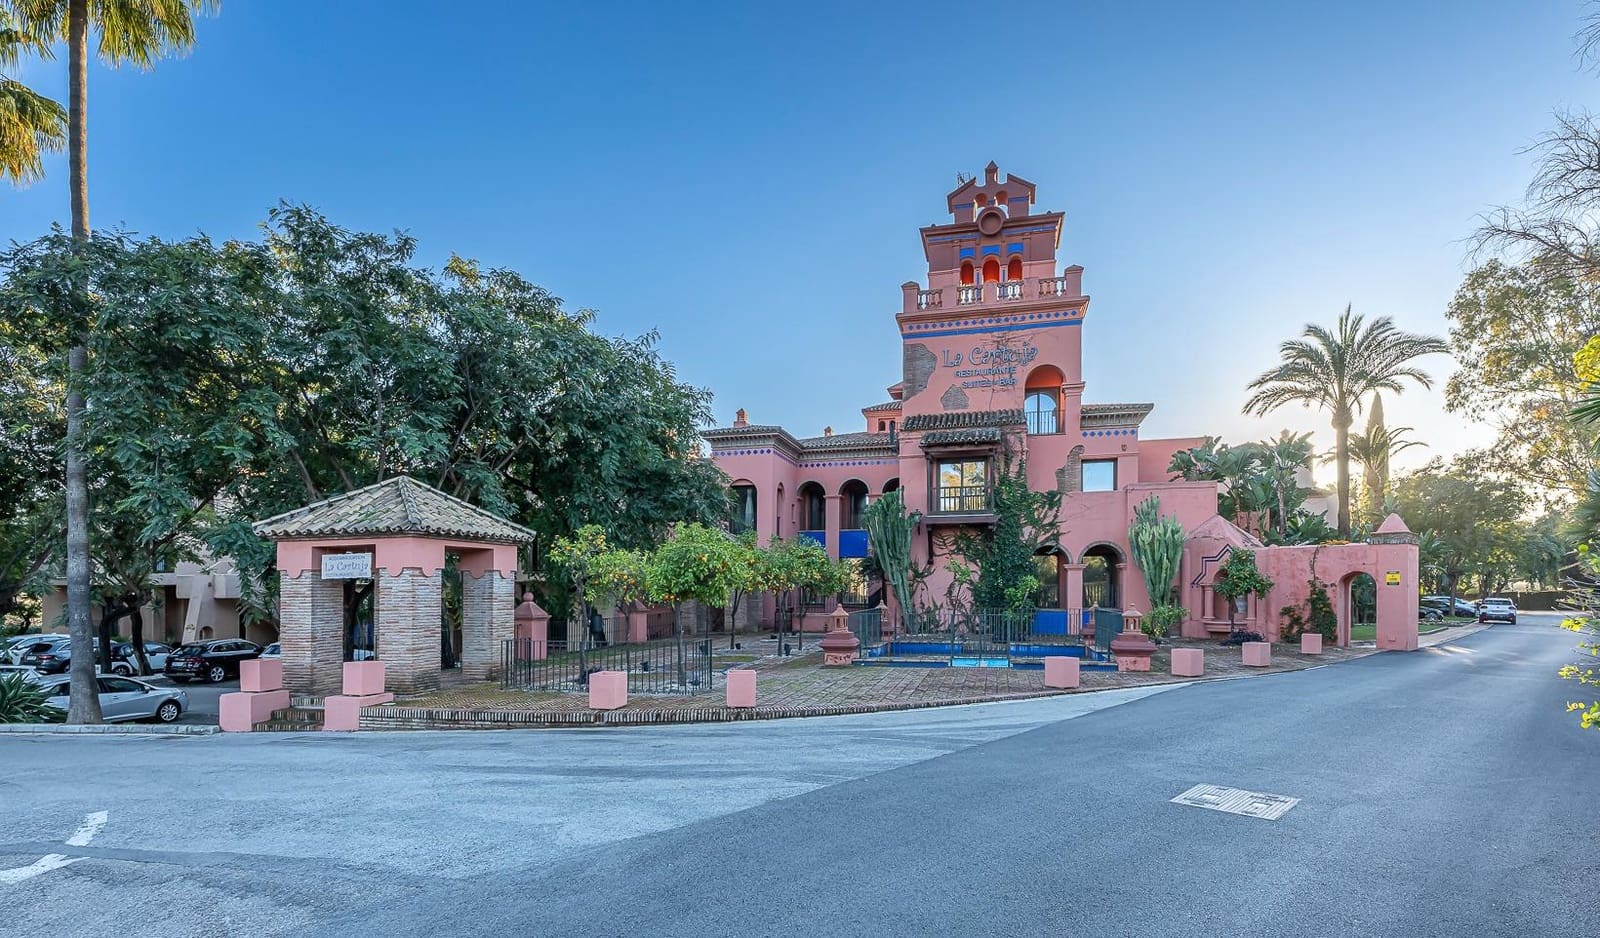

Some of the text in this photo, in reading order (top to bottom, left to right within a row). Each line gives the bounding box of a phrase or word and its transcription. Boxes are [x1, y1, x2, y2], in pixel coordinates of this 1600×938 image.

[942, 341, 1038, 368] La Cartuja
[954, 366, 1017, 377] RESTAURANTE
[325, 559, 369, 572] La Cartuja
